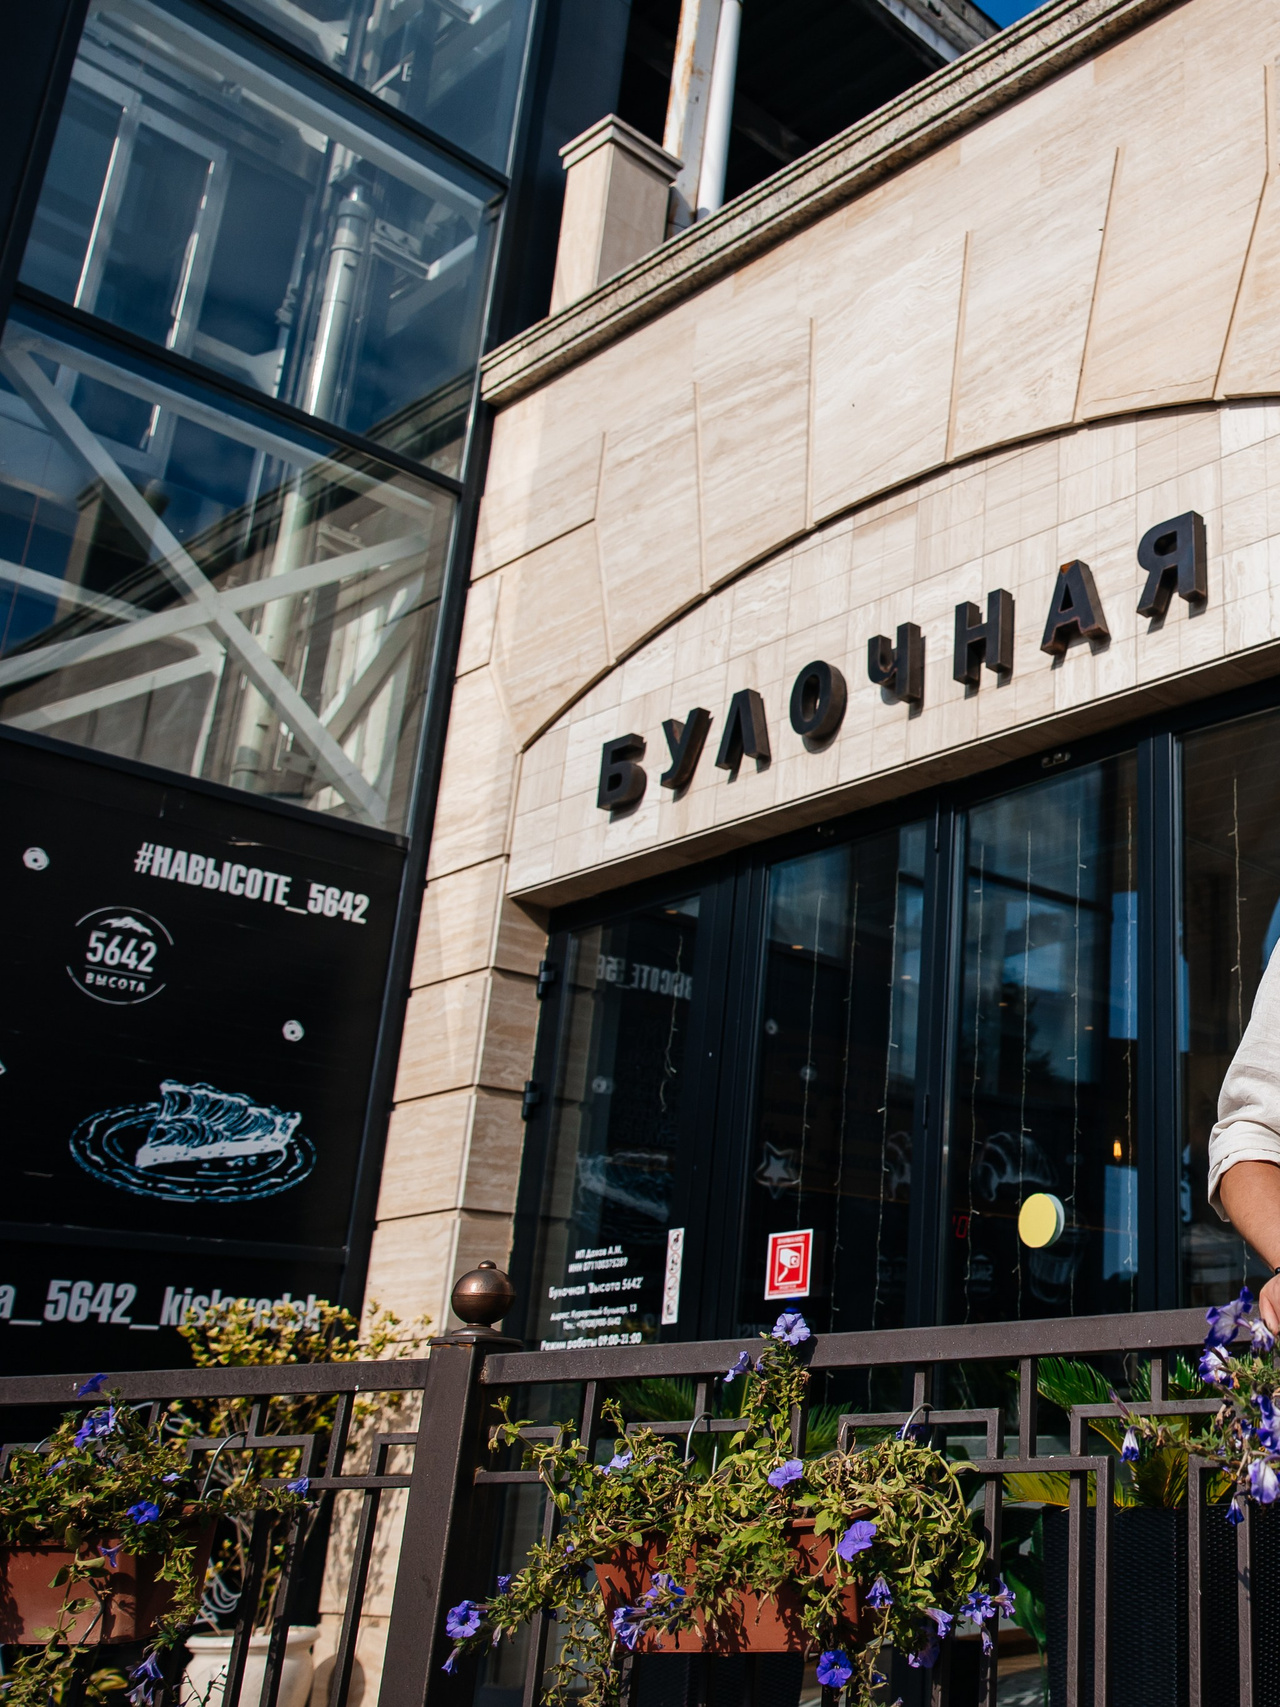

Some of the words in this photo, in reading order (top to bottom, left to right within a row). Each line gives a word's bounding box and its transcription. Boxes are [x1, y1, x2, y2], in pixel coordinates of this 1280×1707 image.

[596, 510, 1208, 812] БУЛОЧНАЯ
[134, 842, 370, 924] #НАВЫСОТЕ_5642
[86, 930, 157, 973] 5642
[85, 972, 145, 993] ВЫСОТА
[548, 1285, 586, 1300] Булочная
[541, 1340, 566, 1352] Режим
[566, 1337, 597, 1350] работы
